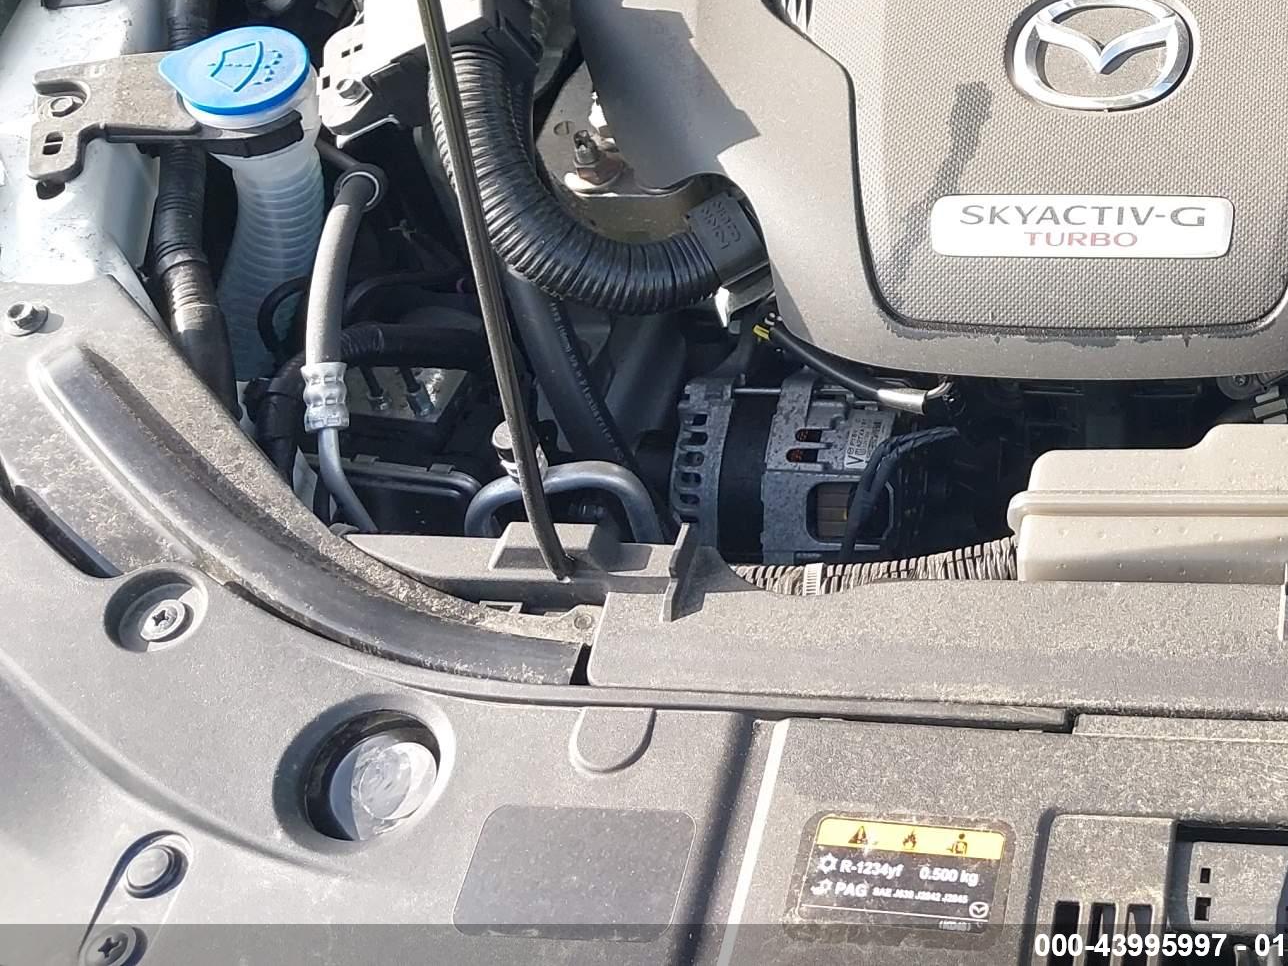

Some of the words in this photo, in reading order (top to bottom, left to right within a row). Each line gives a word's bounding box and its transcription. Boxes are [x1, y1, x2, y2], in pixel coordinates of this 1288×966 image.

[959, 204, 1206, 227] SKYACTIV-G
[1024, 231, 1138, 248] TURBO
[839, 859, 904, 880] R-1234yf
[919, 866, 959, 883] 0.500
[960, 869, 979, 888] kg
[835, 882, 867, 898] PAG
